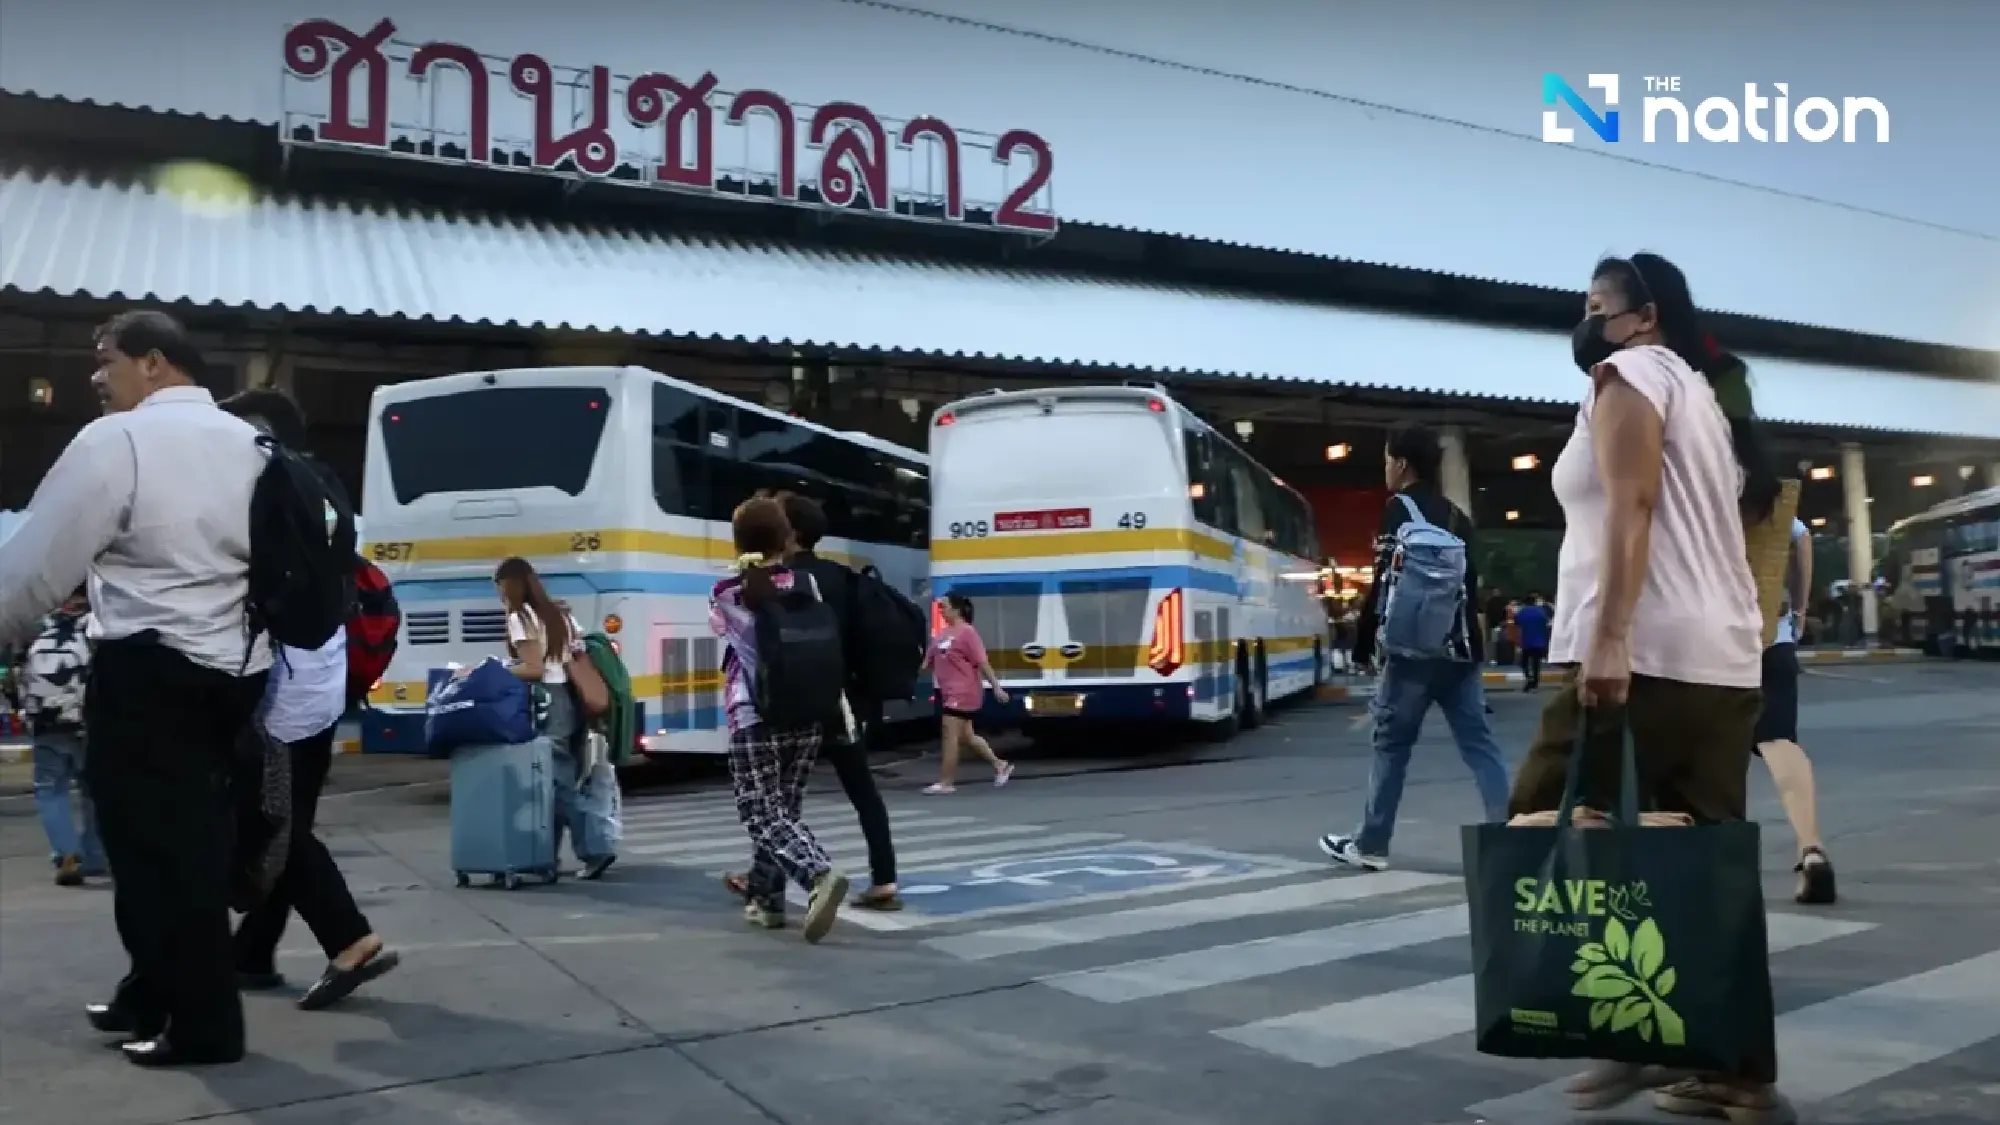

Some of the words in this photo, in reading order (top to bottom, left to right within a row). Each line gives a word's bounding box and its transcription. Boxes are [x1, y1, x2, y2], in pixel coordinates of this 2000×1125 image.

[284, 17, 965, 222] ชานชาลา
[992, 129, 1059, 233] 2
[949, 519, 989, 539] 909
[1117, 511, 1148, 529] 49
[374, 542, 414, 562] 957
[1514, 877, 1606, 915] SAVE
[1513, 919, 1538, 933] THE
[1540, 920, 1589, 936] PLANET
